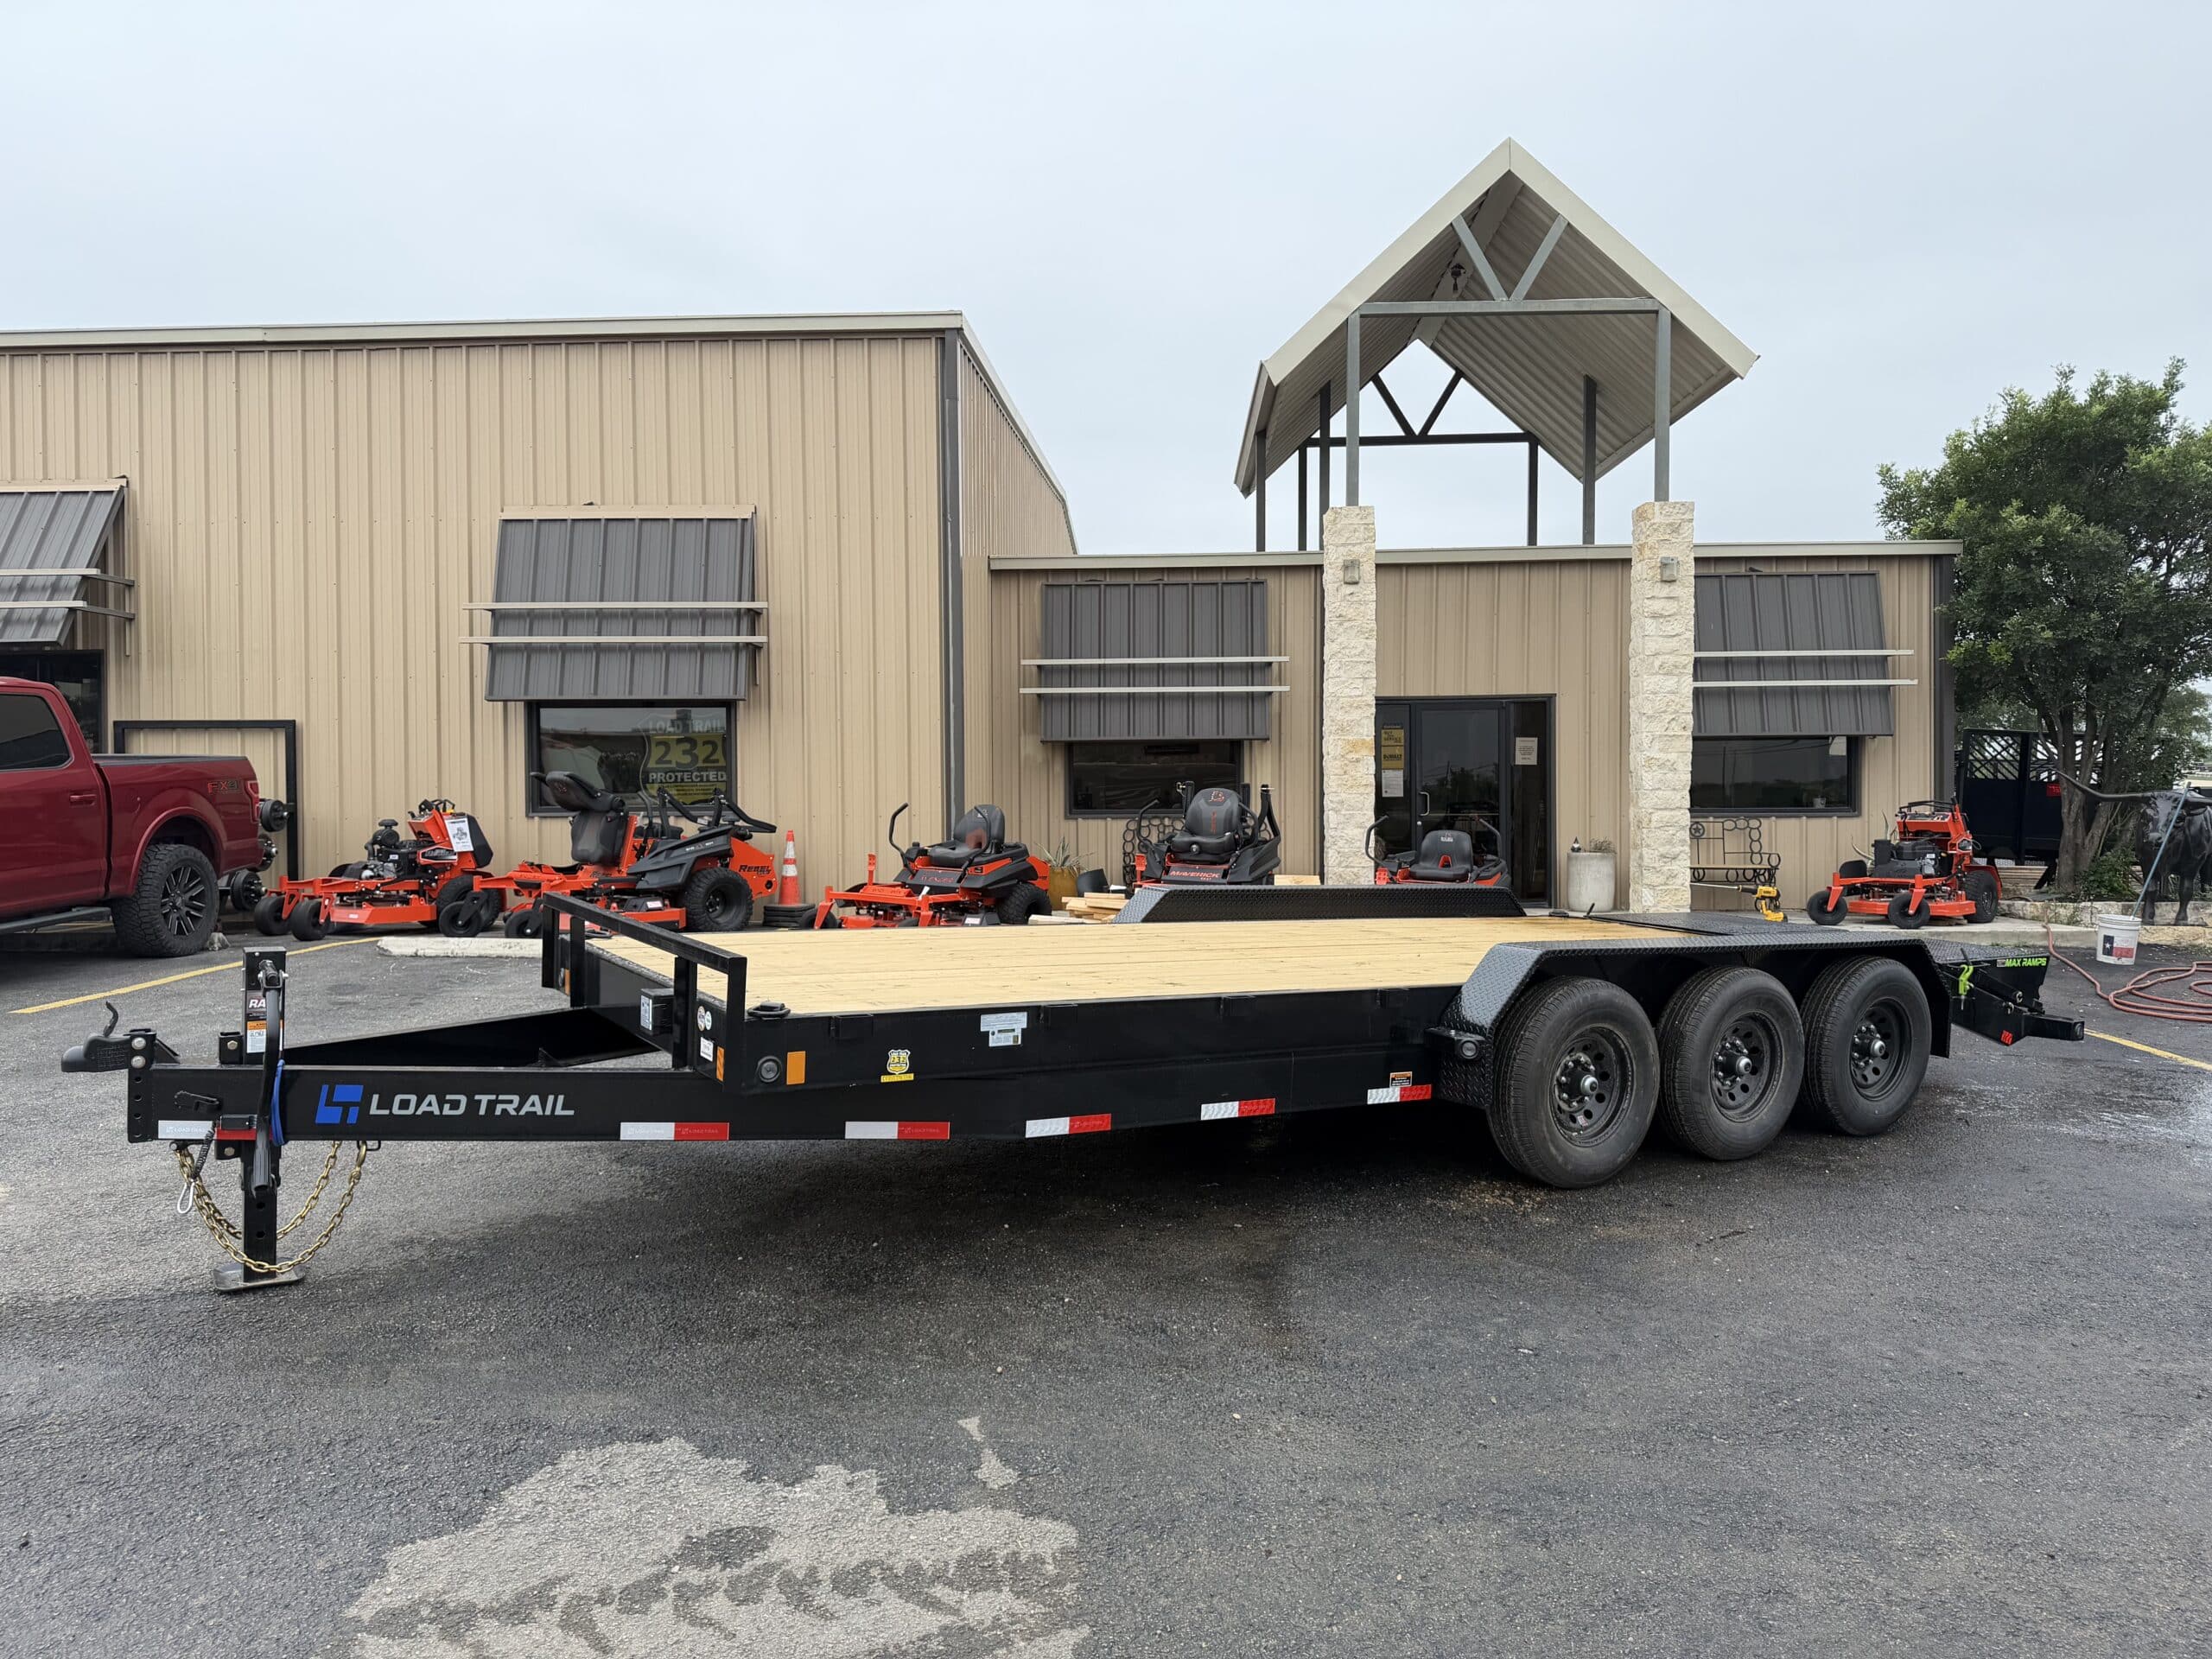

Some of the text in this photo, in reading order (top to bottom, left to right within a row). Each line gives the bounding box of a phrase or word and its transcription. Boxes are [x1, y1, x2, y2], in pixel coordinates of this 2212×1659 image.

[649, 718, 725, 734] LOAD TRAIL
[655, 736, 720, 770] 232
[649, 772, 727, 783] PROTECTED
[2005, 957, 2047, 967] MAX RAMPS
[248, 999, 266, 1008] RA
[369, 1093, 575, 1116] LOAD TRAIL
